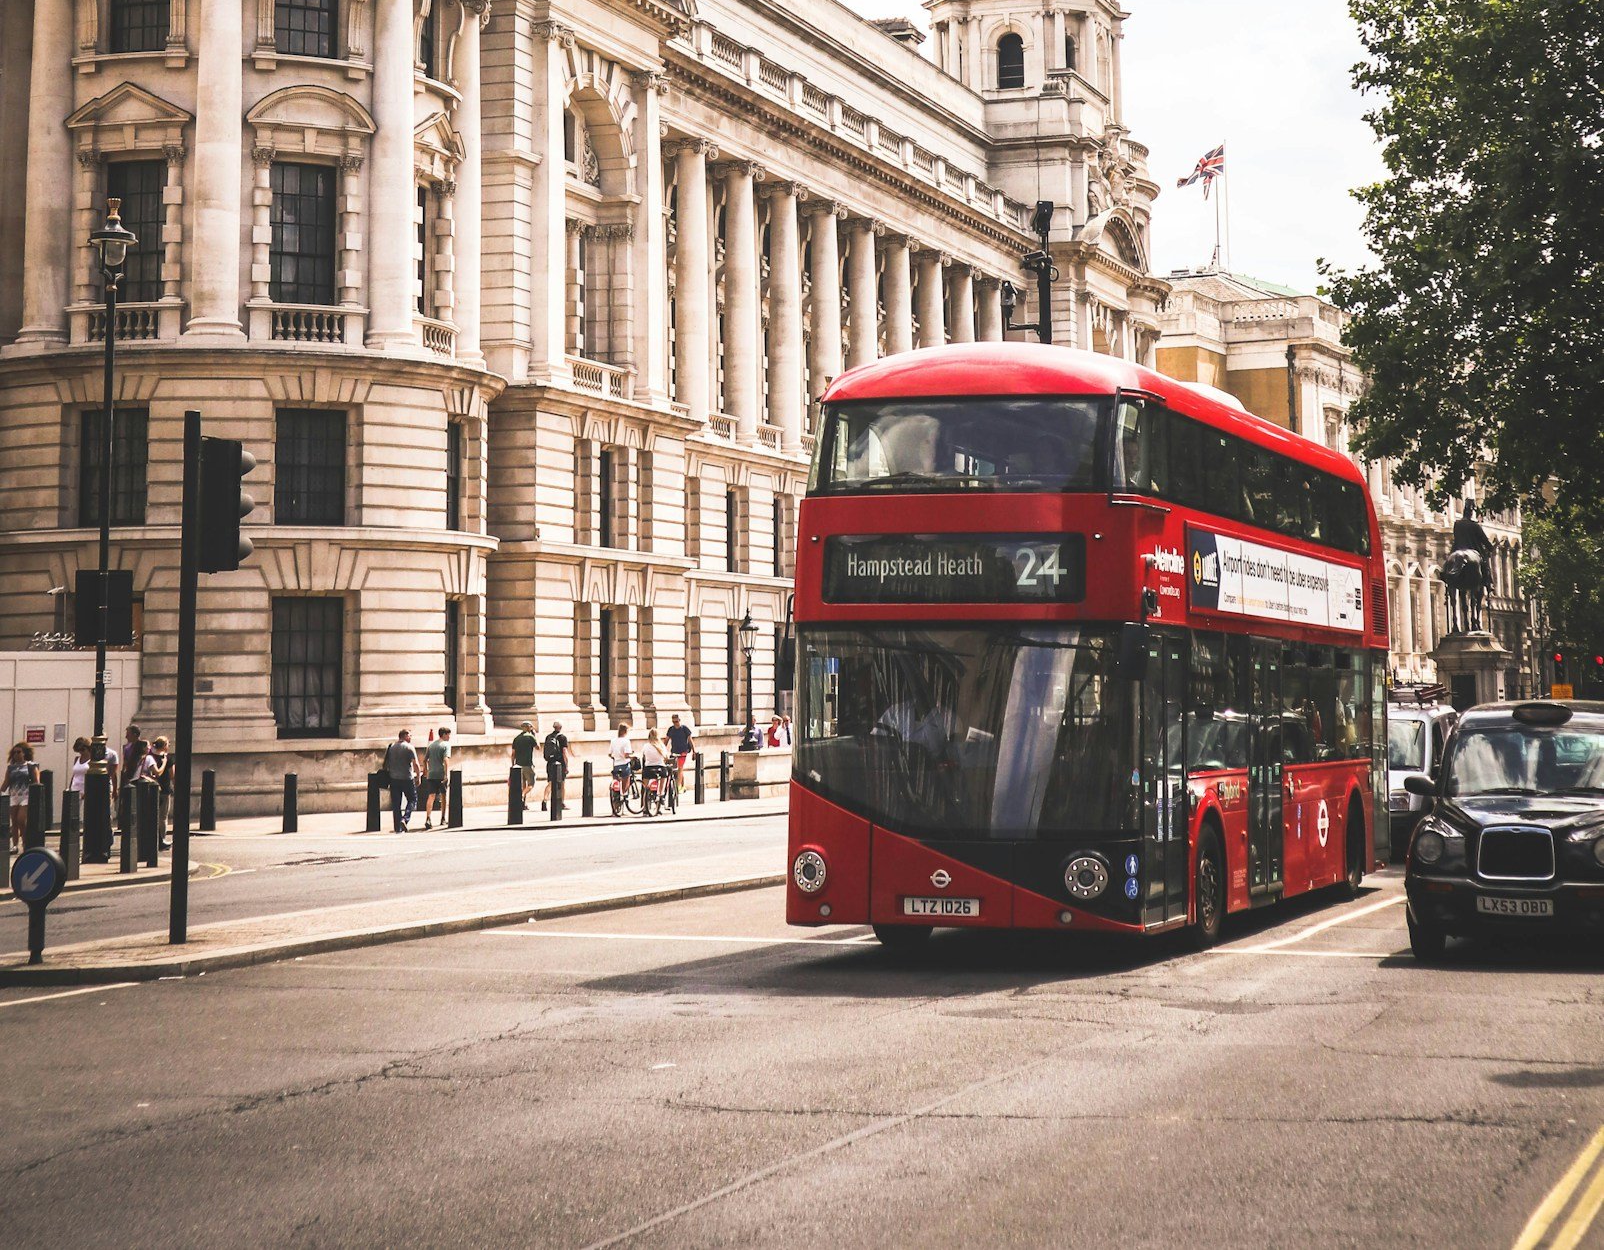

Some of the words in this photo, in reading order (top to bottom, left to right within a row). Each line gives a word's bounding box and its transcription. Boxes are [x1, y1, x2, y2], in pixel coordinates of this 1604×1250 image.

[847, 552, 931, 583] Hampstead
[938, 552, 983, 576] Heath
[1015, 544, 1068, 586] 24
[1153, 544, 1184, 575] Metroline
[1223, 549, 1242, 578] Airport
[1243, 554, 1256, 577] rides
[1257, 557, 1270, 580] don't
[1271, 562, 1283, 583] need
[1289, 566, 1295, 586] be
[1296, 568, 1306, 588] uber
[911, 899, 938, 913] LTZ
[941, 900, 971, 914] 1026
[1482, 897, 1517, 913] LX53
[1521, 900, 1548, 914] OBD
